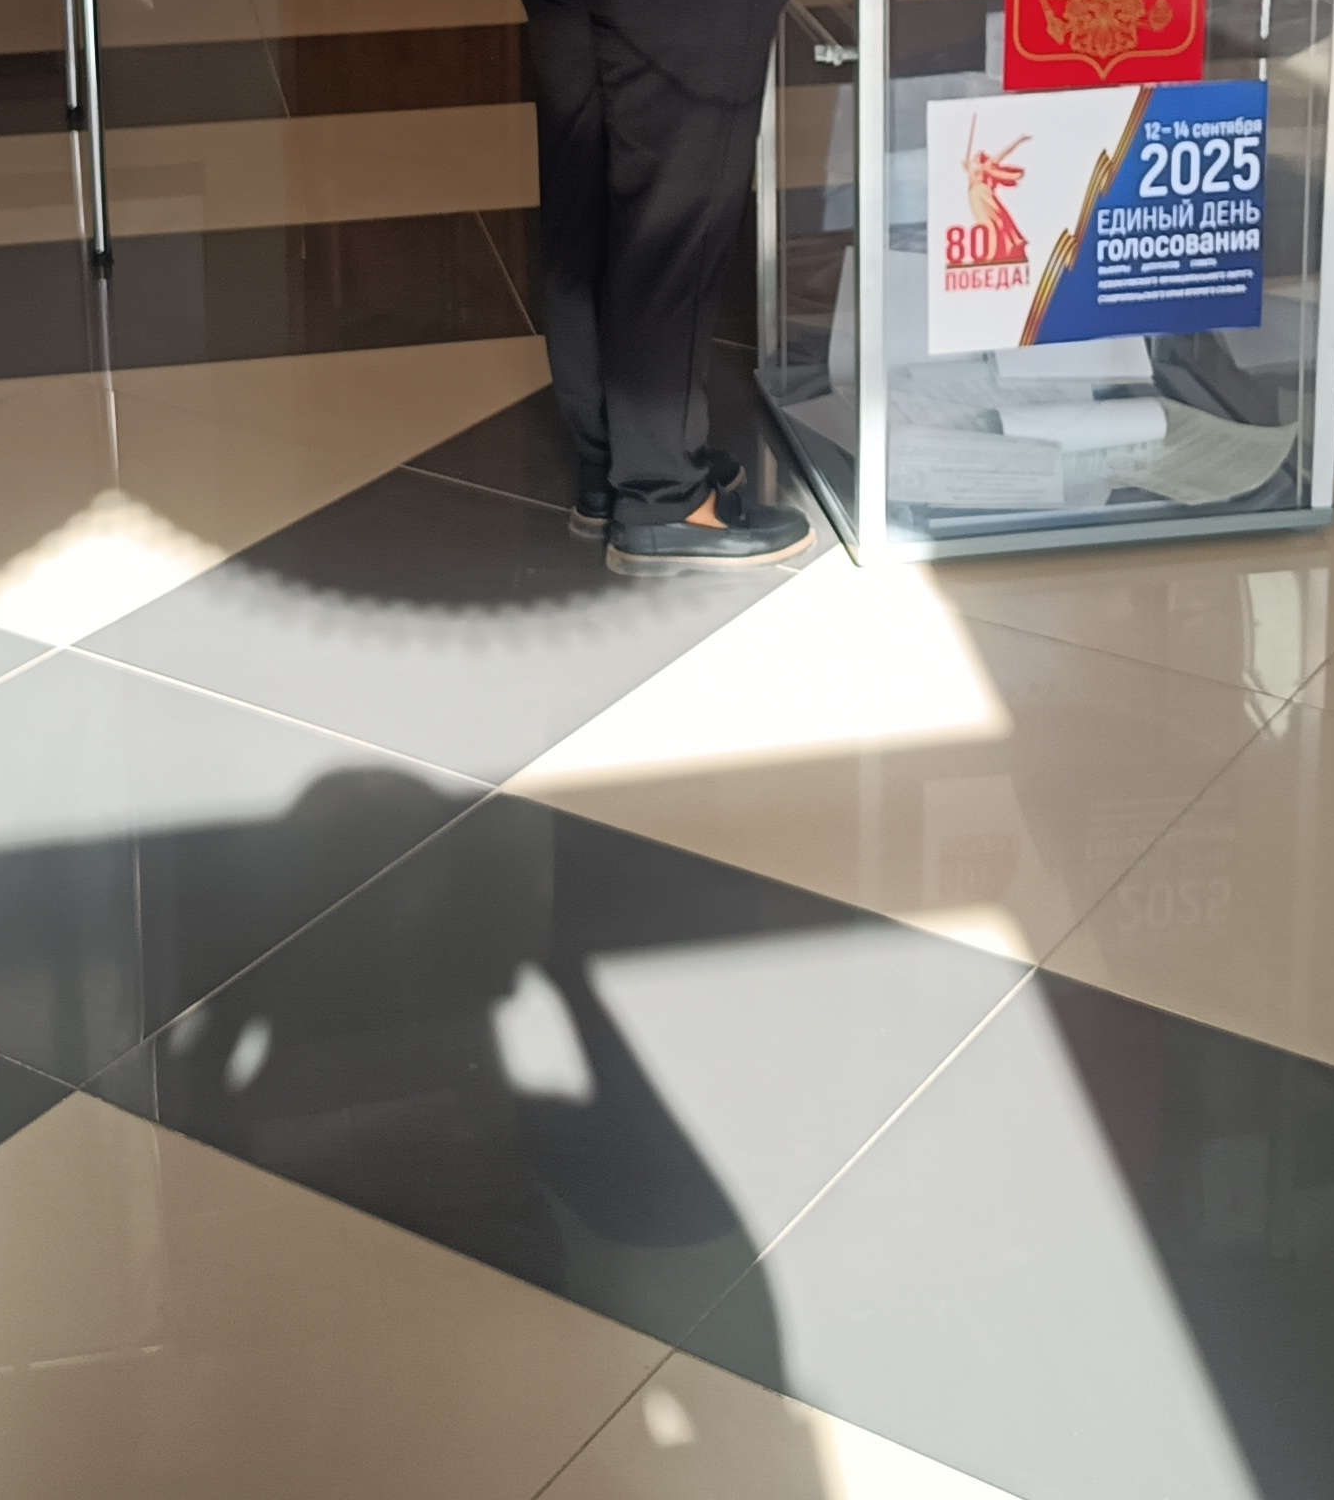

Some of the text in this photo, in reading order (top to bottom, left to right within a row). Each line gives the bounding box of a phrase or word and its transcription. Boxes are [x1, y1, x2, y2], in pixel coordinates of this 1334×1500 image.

[1192, 116, 1263, 136] сентября
[1139, 138, 1260, 198] 2025
[1097, 198, 1261, 237] ЕДИНЫЙ ДЕНЬ
[946, 225, 989, 266] 80
[946, 265, 1030, 291] ПОБЕДА!
